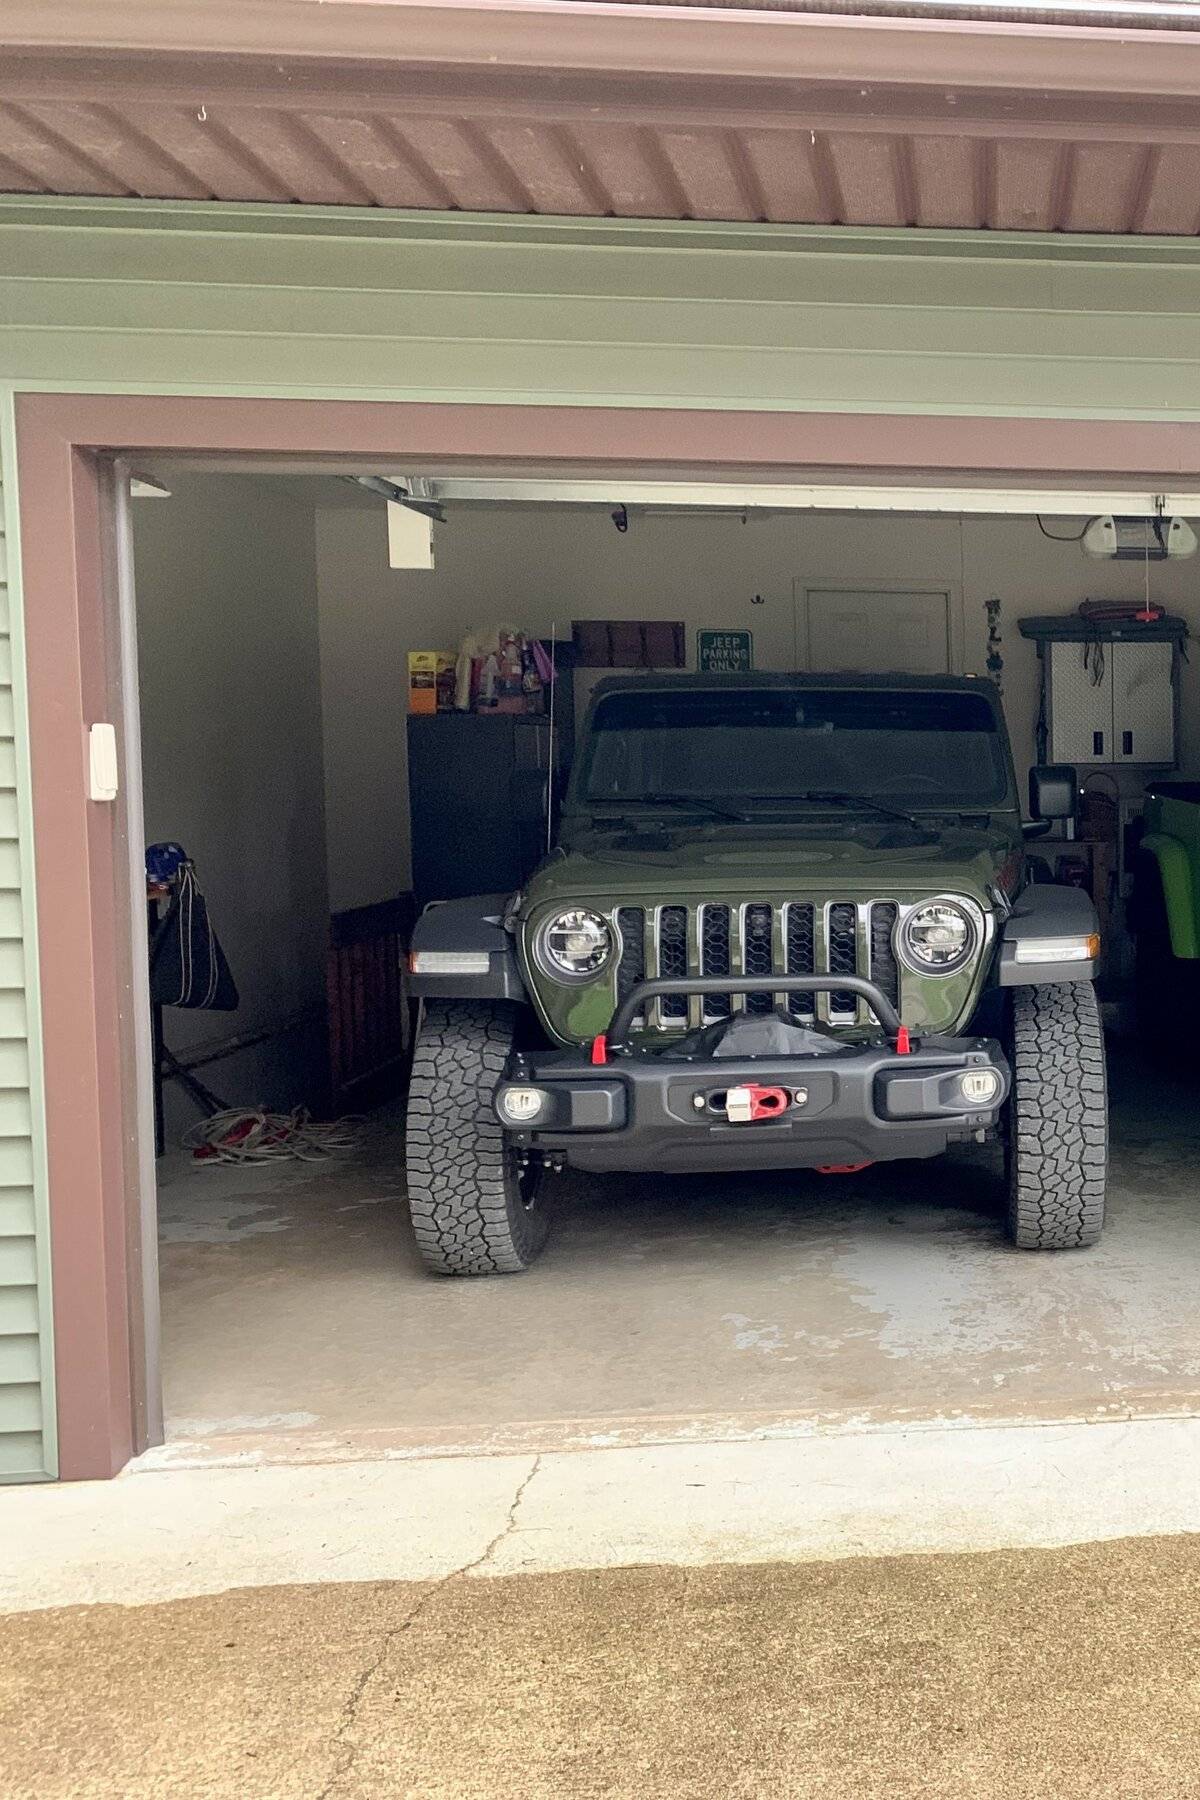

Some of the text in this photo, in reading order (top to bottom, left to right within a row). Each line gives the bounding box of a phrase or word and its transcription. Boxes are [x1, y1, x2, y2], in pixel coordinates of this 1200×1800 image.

[711, 637, 740, 648] JEEP
[703, 648, 747, 660] PARKING
[710, 660, 741, 671] ONLY
